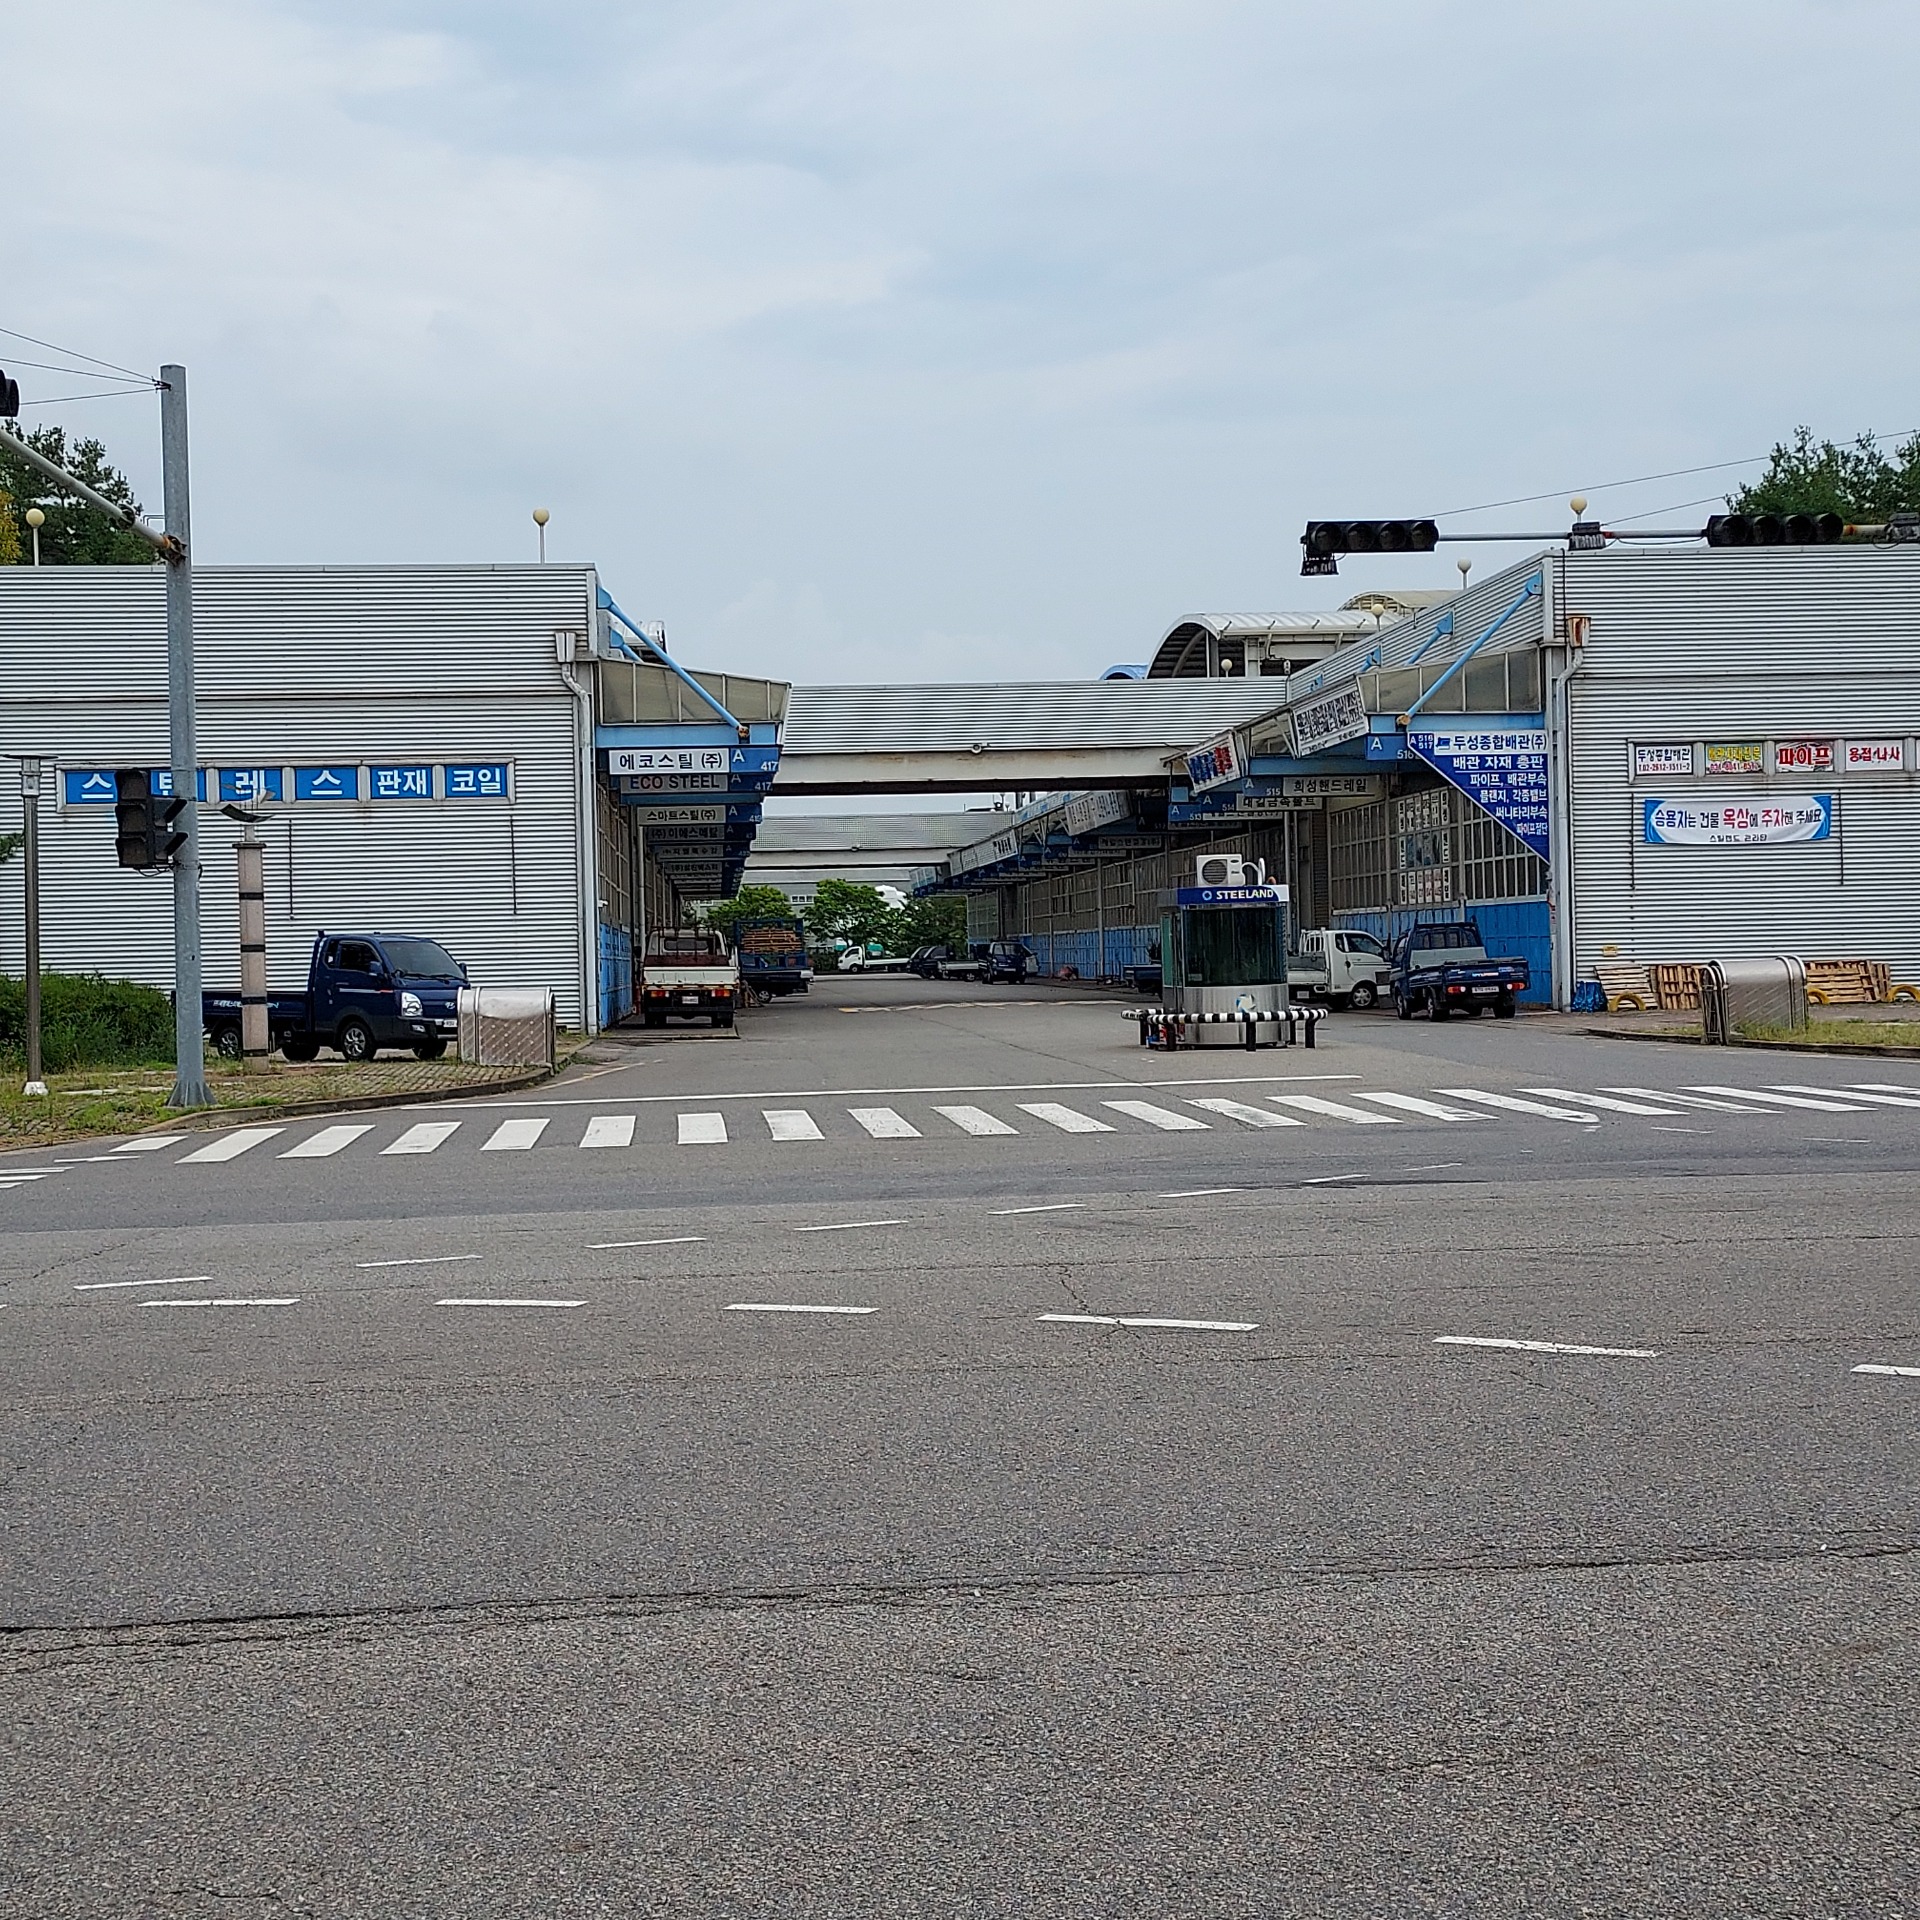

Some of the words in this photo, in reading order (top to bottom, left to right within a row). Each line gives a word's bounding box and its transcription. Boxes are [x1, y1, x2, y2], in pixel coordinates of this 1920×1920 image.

[1371, 737, 1382, 750] A
[1409, 736, 1417, 744] A
[619, 753, 693, 770] 에코스틸
[701, 752, 723, 769] (주)
[733, 749, 745, 763] A
[761, 761, 779, 771] 417
[1453, 756, 1480, 770] 배관
[1485, 756, 1512, 769] 자재
[1779, 747, 1830, 766] 파이프
[377, 769, 427, 795] 판재
[451, 768, 501, 794] 코일
[630, 775, 663, 790] ECO
[669, 775, 720, 789] STEEL
[731, 774, 742, 784] A
[1293, 778, 1367, 793] 희성핸드레일
[1245, 778, 1254, 789] A
[1266, 787, 1281, 796] 515
[1171, 804, 1180, 815] A
[1203, 795, 1212, 805] A
[1222, 803, 1235, 811] 514
[729, 806, 738, 816] A
[1655, 808, 1696, 829] 승용차는
[1700, 812, 1719, 829] 건물
[1723, 808, 1759, 829] 옥상에
[1761, 808, 1793, 827] 주차해
[1796, 808, 1822, 824] 주세요
[1216, 889, 1274, 900] STEELAND
